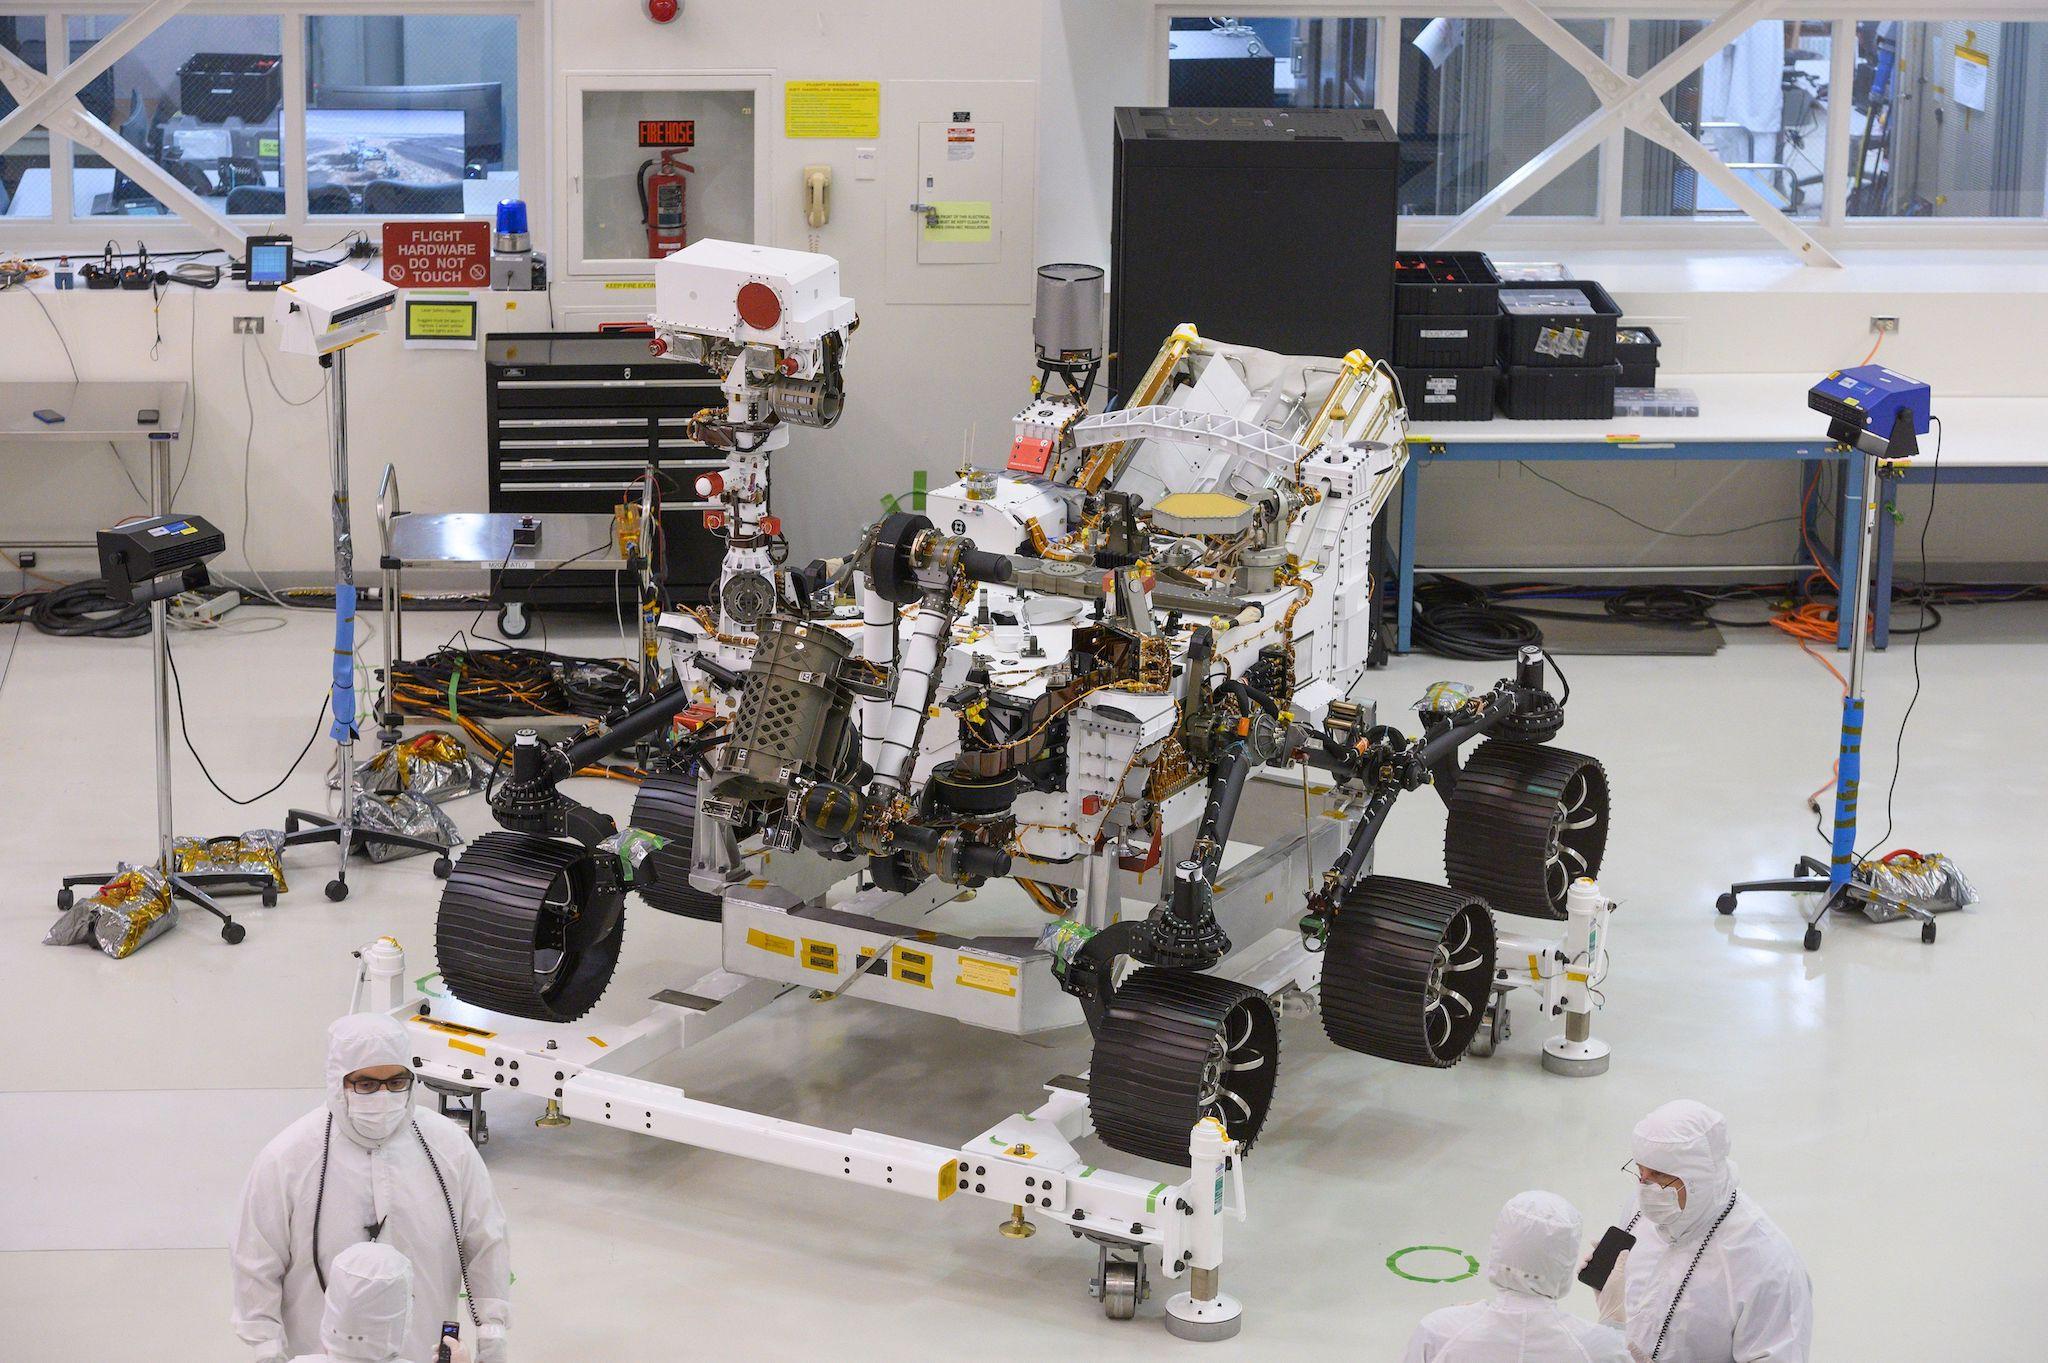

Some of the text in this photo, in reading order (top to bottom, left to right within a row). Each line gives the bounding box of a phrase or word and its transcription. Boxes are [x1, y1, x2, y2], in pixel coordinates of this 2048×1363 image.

[640, 121, 693, 143] FIRE HOSE
[412, 230, 463, 242] FLIGHT
[398, 244, 476, 255] HARDWARE
[409, 257, 466, 269] DO NOT
[413, 271, 462, 282] TOUCH
